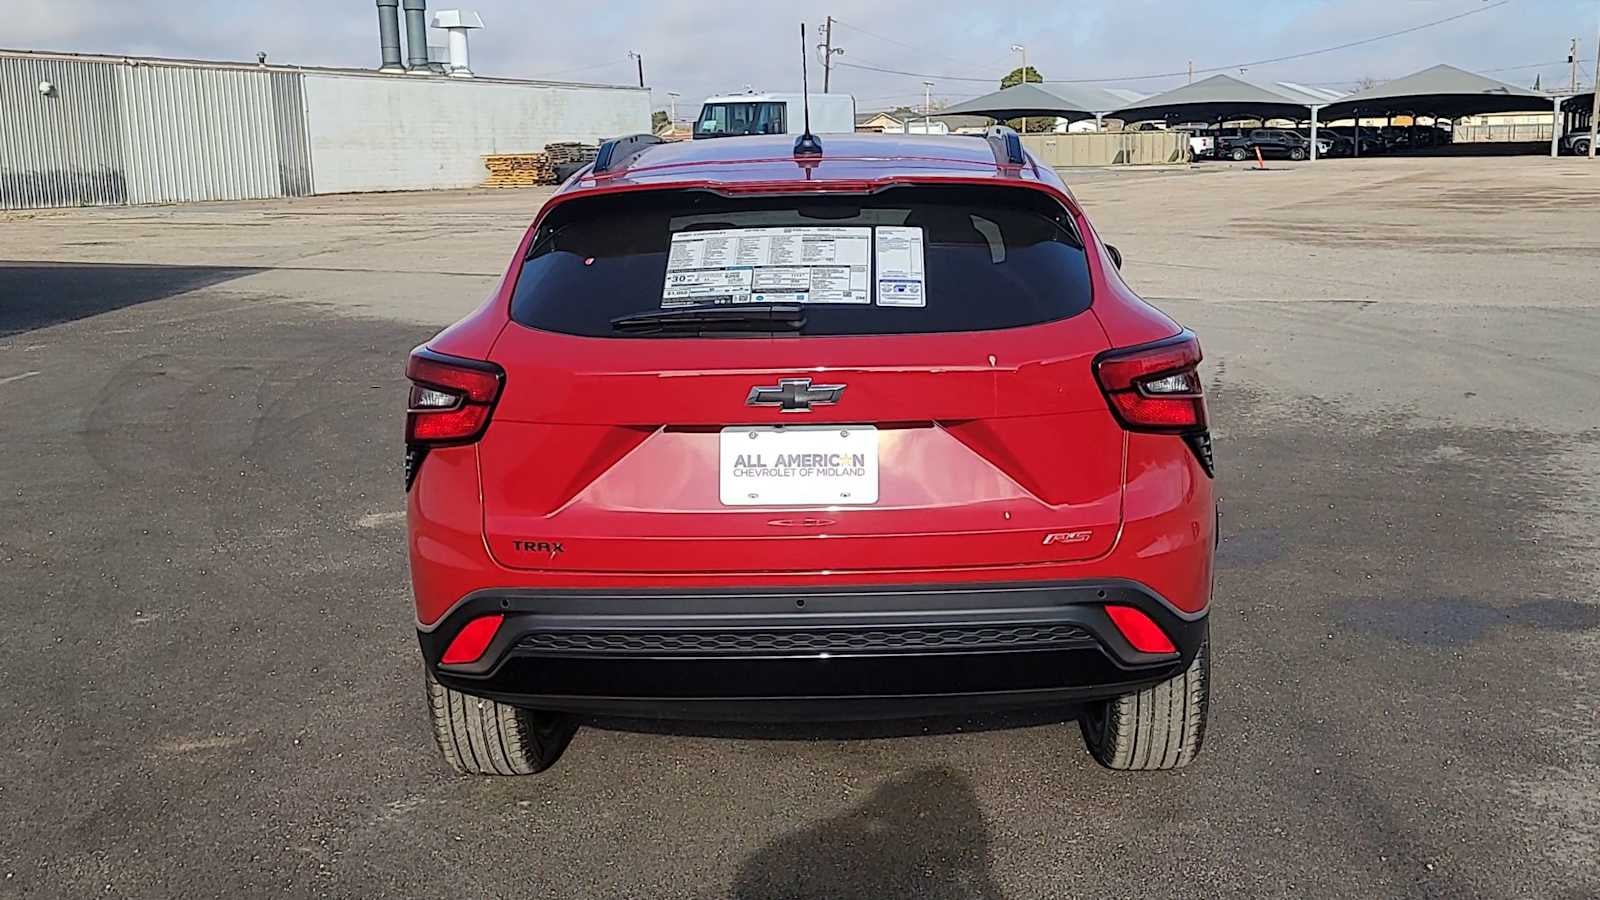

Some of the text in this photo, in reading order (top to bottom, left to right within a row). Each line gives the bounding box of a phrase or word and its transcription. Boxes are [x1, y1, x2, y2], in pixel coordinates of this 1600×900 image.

[734, 454, 767, 468] ALL
[733, 468, 866, 478] CHEVROLET OF MIDLAND
[512, 541, 564, 553] TRAX
